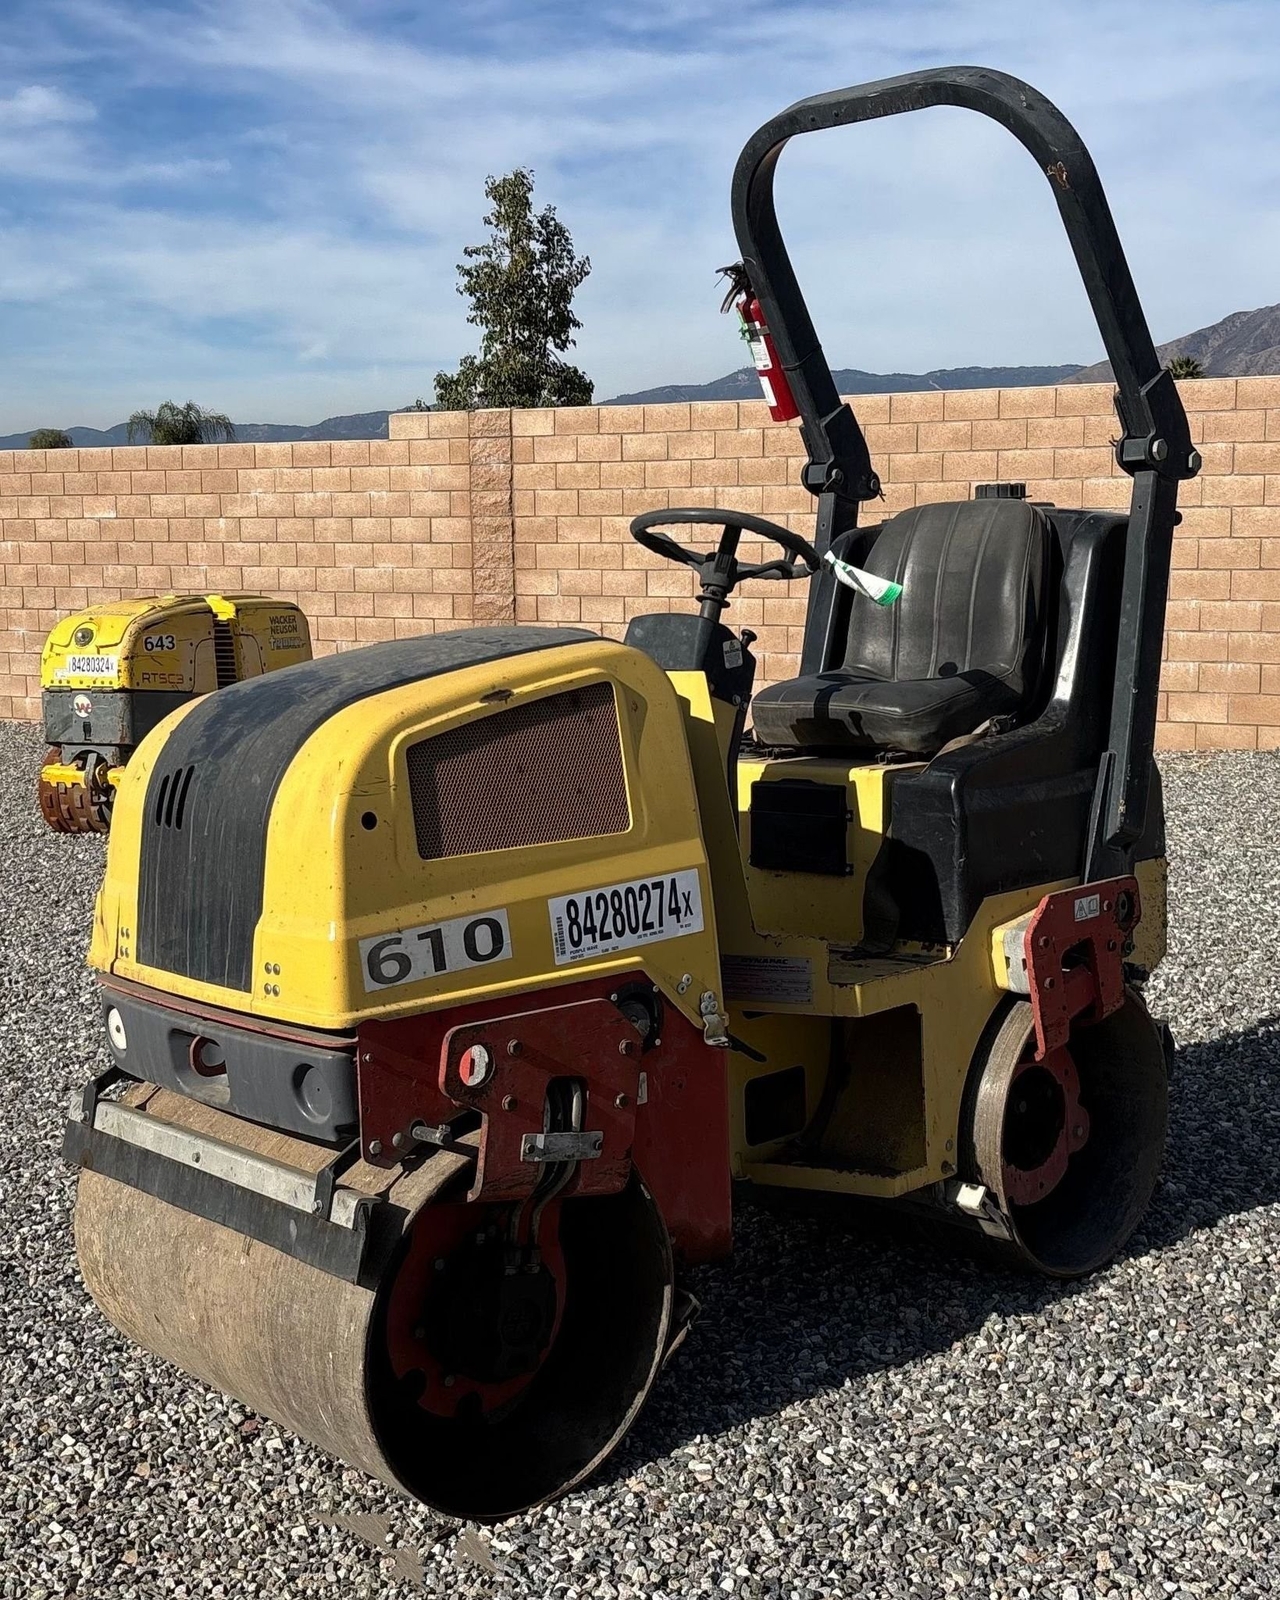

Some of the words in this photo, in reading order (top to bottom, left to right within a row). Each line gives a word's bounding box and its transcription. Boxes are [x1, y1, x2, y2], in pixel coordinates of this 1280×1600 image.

[269, 615, 297, 625] WACKER
[270, 624, 298, 635] NEUSON
[144, 635, 176, 652] 643
[367, 917, 504, 985] 610
